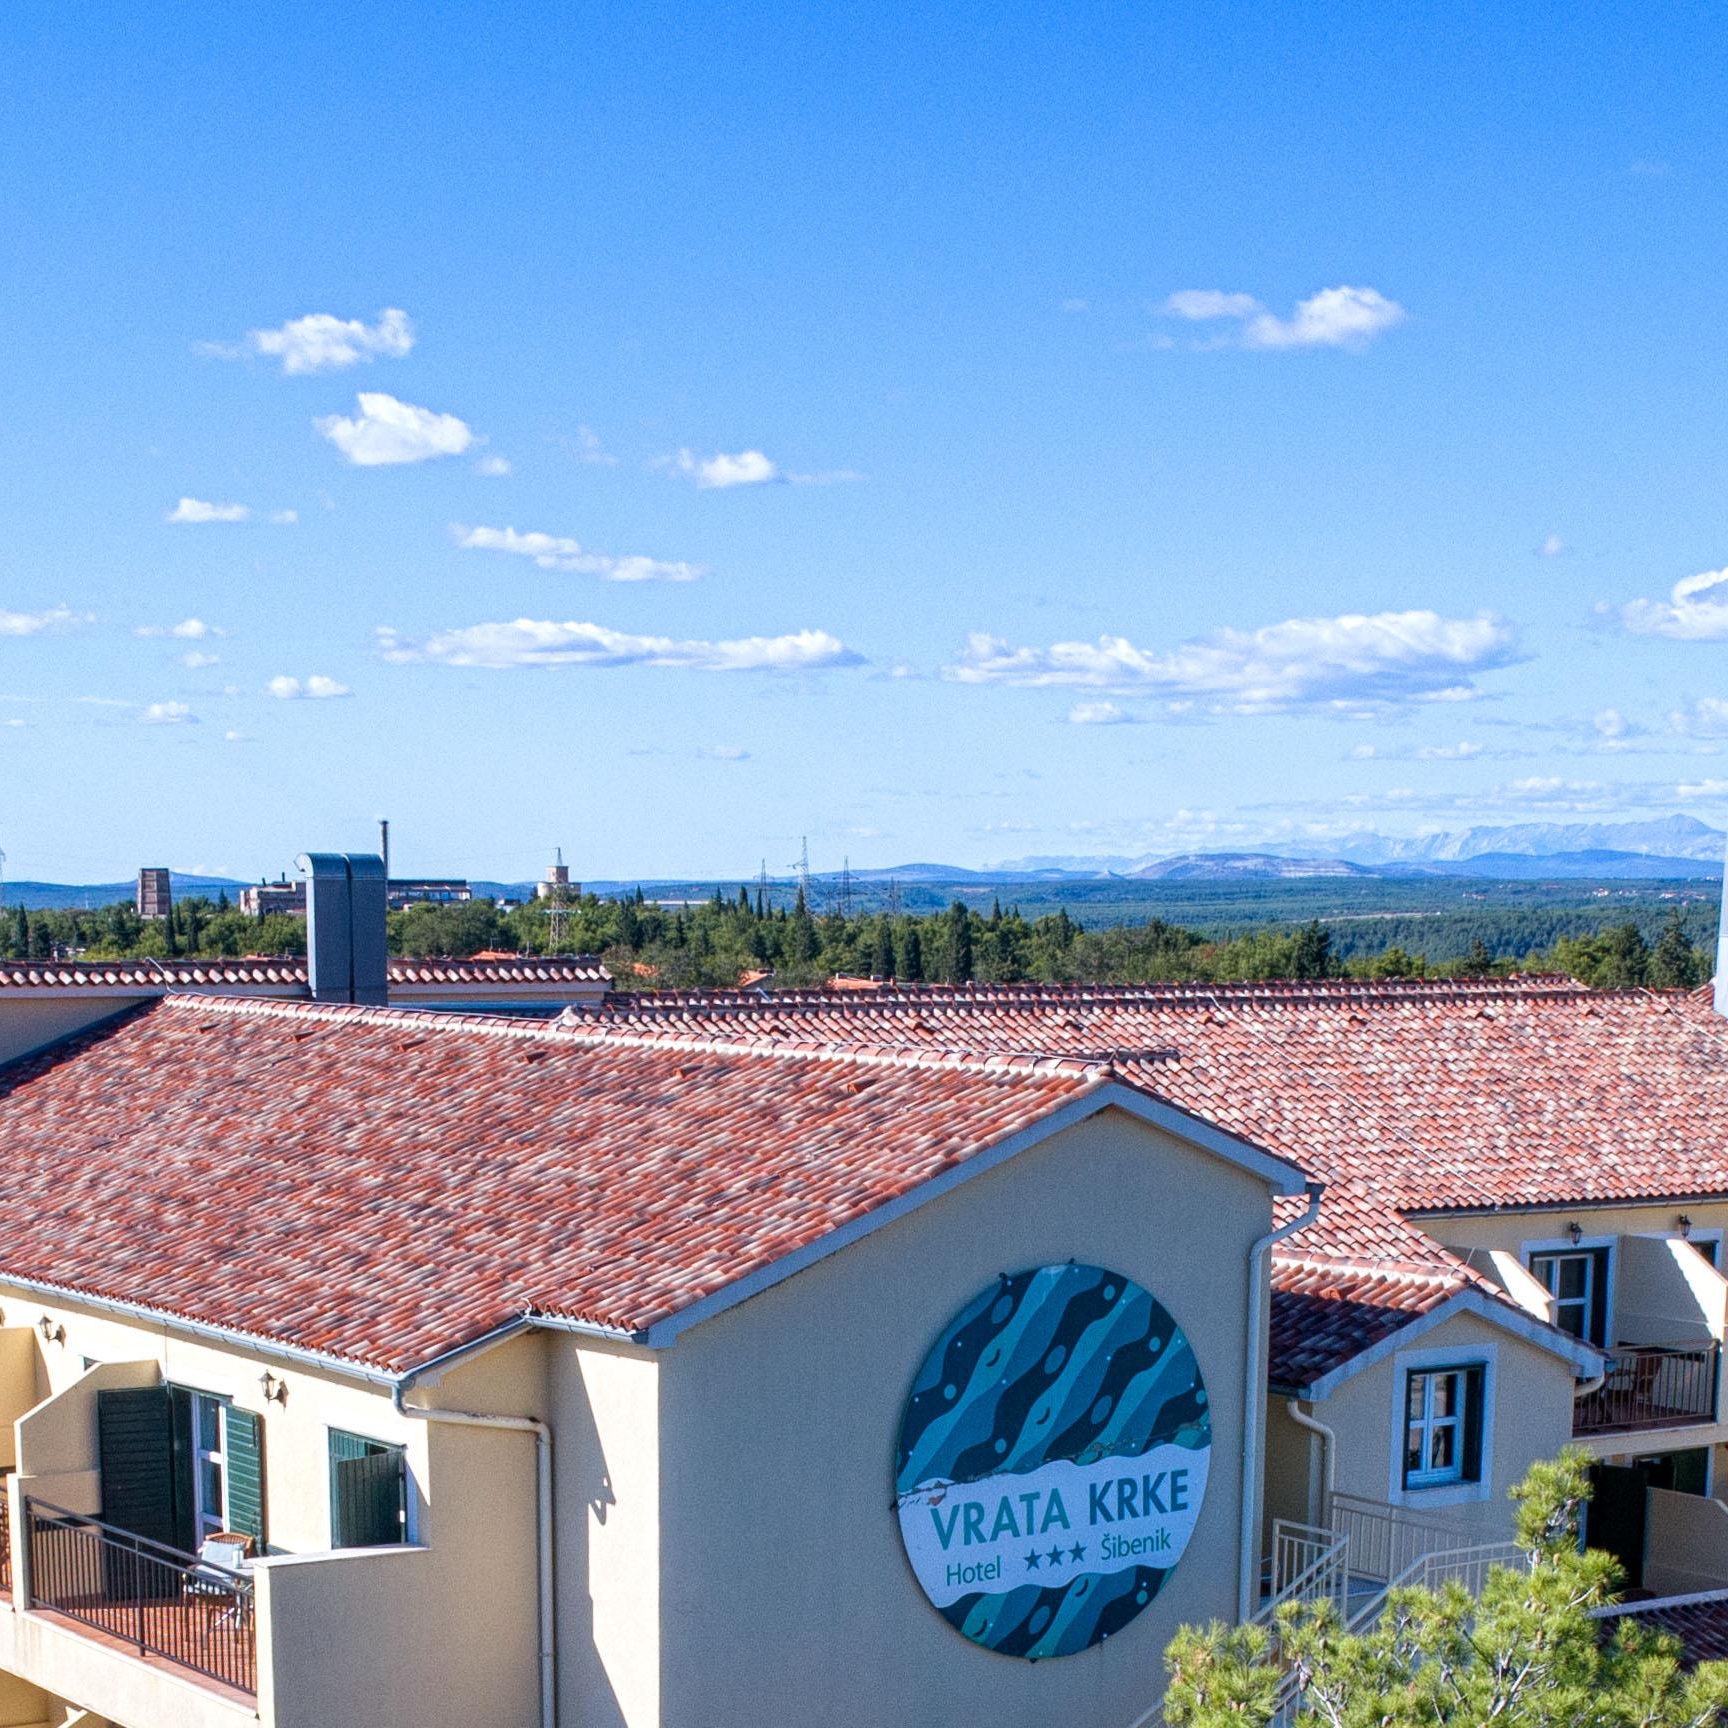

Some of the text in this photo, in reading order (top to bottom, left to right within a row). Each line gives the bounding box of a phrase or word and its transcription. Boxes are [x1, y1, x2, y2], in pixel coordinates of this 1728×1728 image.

[930, 1468, 1189, 1550] VRATA KRKE
[945, 1527, 1171, 1586] Hotel Šibenik
